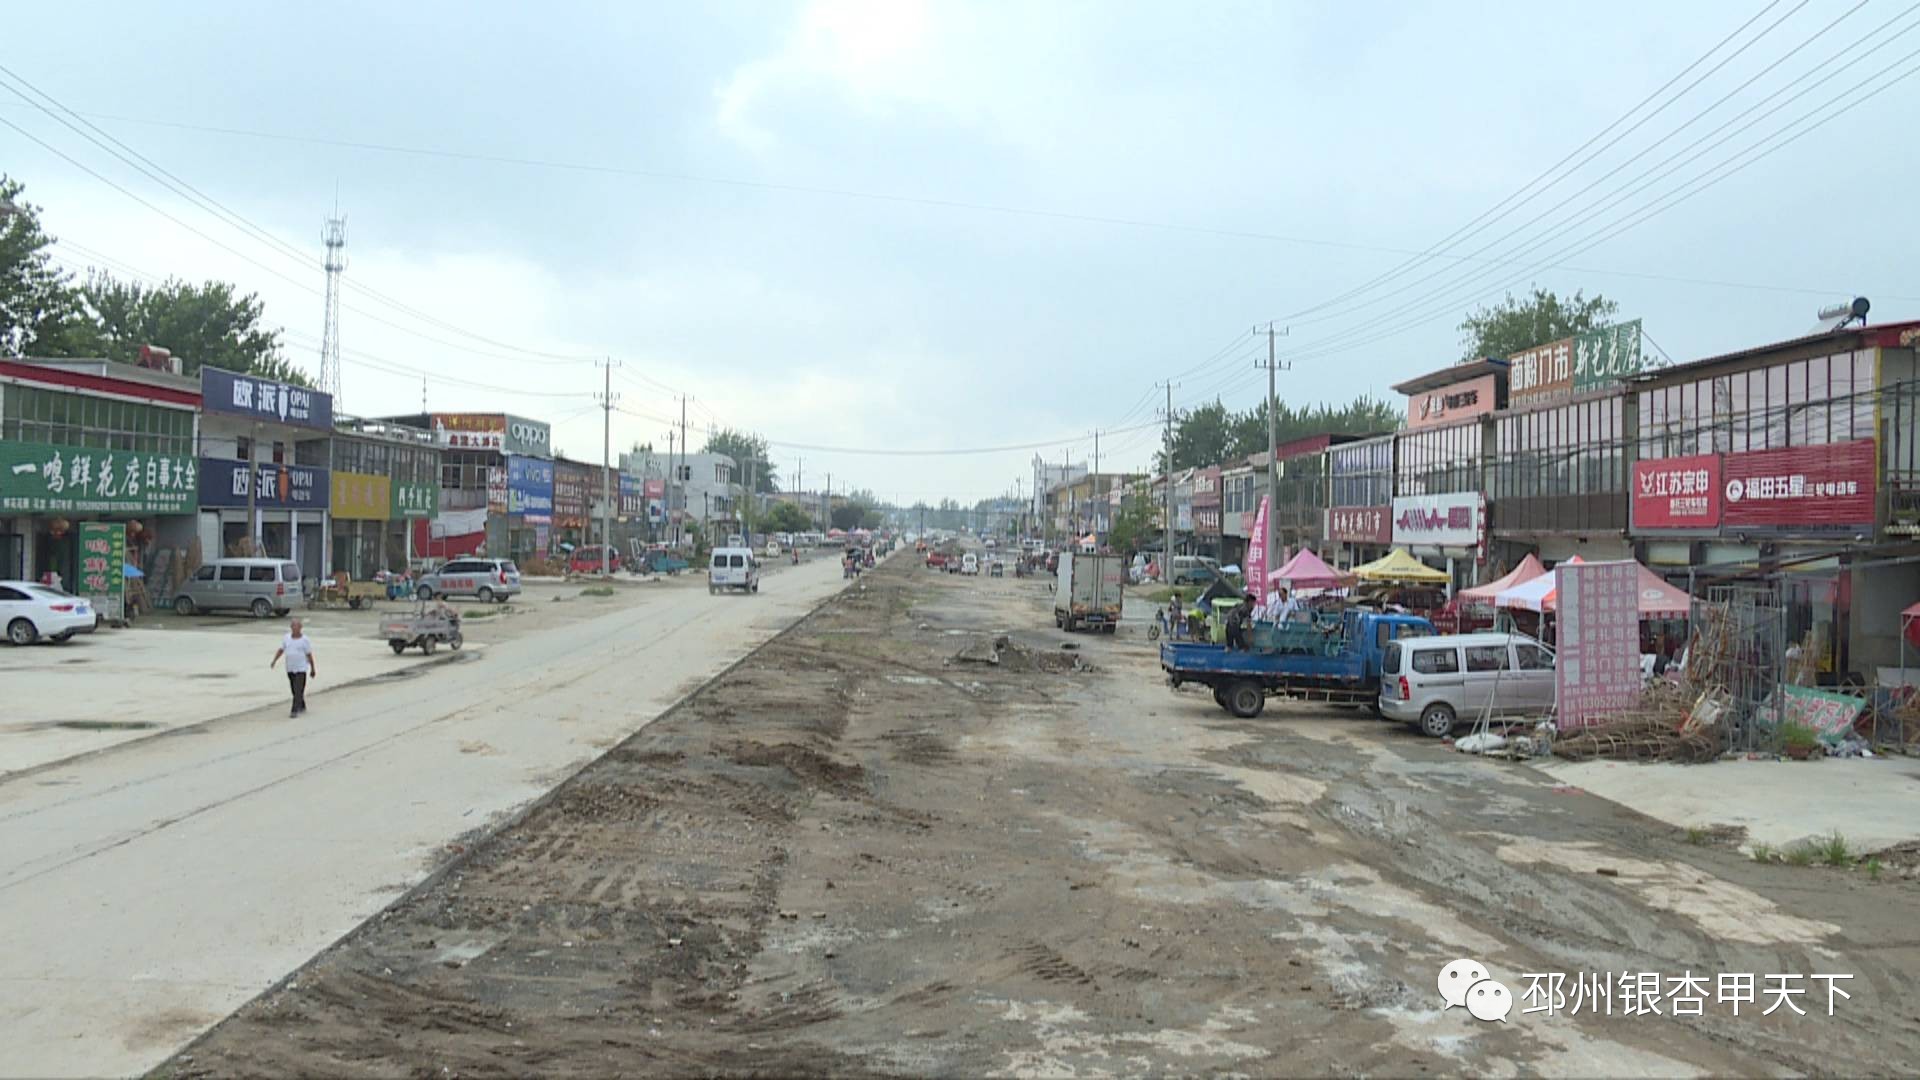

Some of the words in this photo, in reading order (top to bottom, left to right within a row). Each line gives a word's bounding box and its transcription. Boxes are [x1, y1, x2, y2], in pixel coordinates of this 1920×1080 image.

[1511, 344, 1568, 391] 面粉门市
[233, 379, 276, 413] 欧派
[290, 389, 310, 409] OPAI
[12, 451, 140, 497] 一鸣鲜花店
[146, 456, 196, 490] 白事大全
[292, 471, 313, 487] OPAI
[525, 466, 540, 483] vivo
[1656, 467, 1708, 497] 江苏宗申
[1745, 474, 1804, 499] 福田五星
